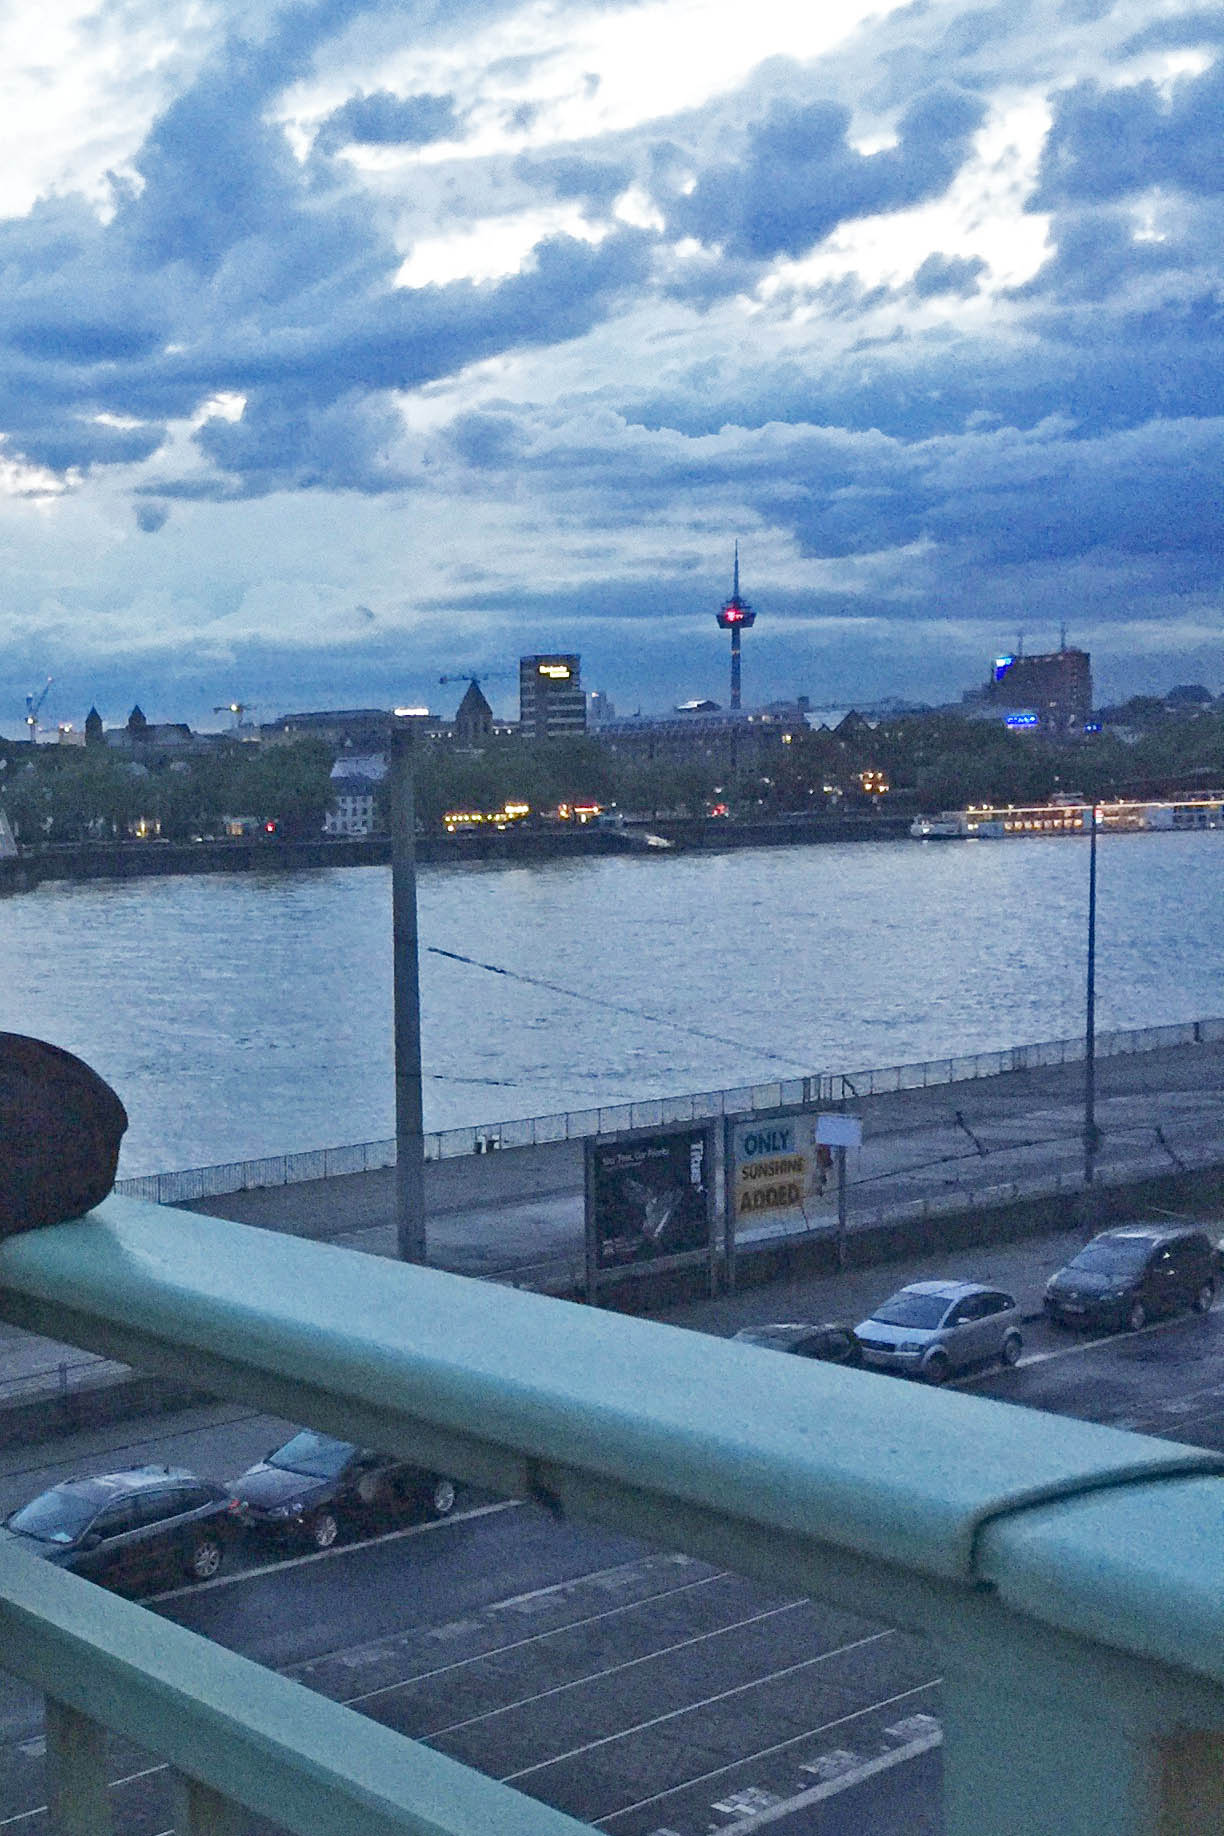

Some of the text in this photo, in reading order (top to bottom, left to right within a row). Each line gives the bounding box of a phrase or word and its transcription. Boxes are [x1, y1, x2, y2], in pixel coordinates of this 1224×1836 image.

[744, 1129, 789, 1155] ONLY
[742, 1158, 804, 1180] SUNSHINE
[741, 1184, 800, 1211] ADDED
